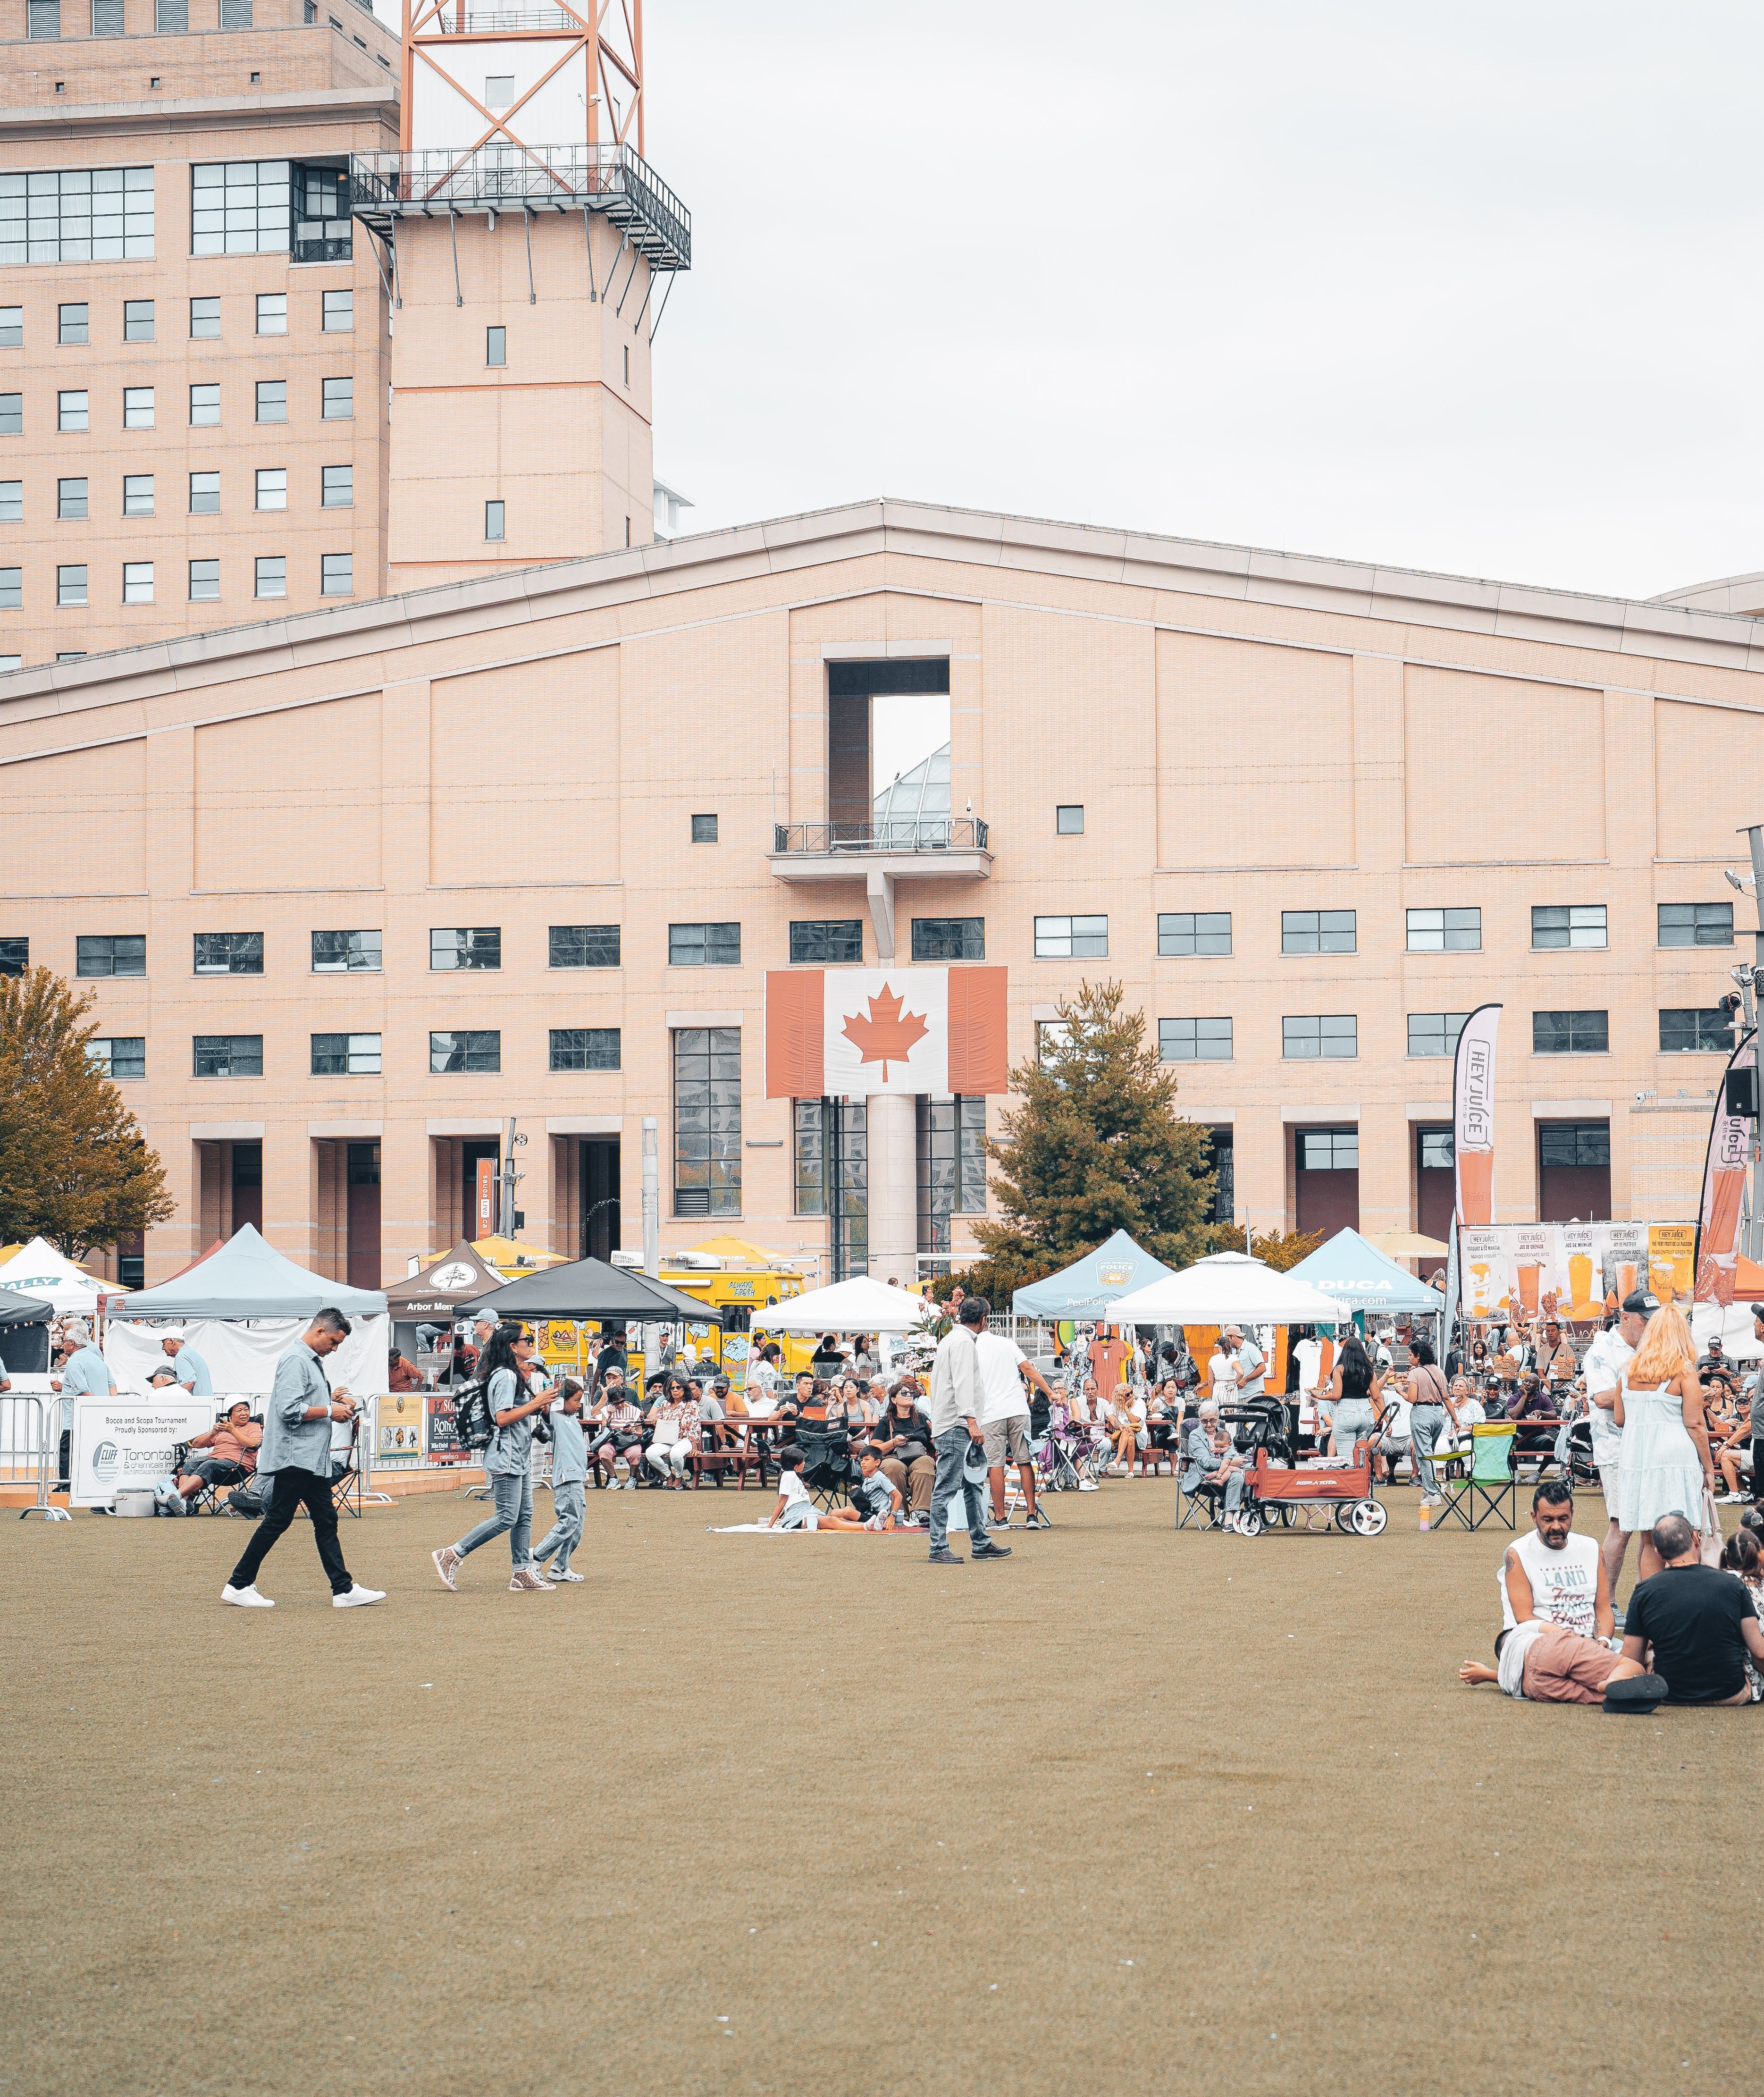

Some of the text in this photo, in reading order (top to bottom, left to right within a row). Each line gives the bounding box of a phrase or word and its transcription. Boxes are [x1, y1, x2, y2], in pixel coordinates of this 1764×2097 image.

[1469, 1051, 1489, 1133] HEY JUICE
[1530, 1232, 1543, 1240] JUICE
[1576, 1230, 1589, 1238] JUICE
[1622, 1230, 1635, 1238] JUICE
[1671, 1230, 1684, 1238] JUICE
[1318, 1280, 1394, 1290] DUCA
[406, 1303, 433, 1311] Arbor
[115, 1426, 136, 1434] Proudly
[138, 1426, 167, 1434] Sponsored
[101, 1449, 118, 1460] CLIFF
[122, 1449, 171, 1461] Toronto
[1543, 1570, 1588, 1586] LAND
